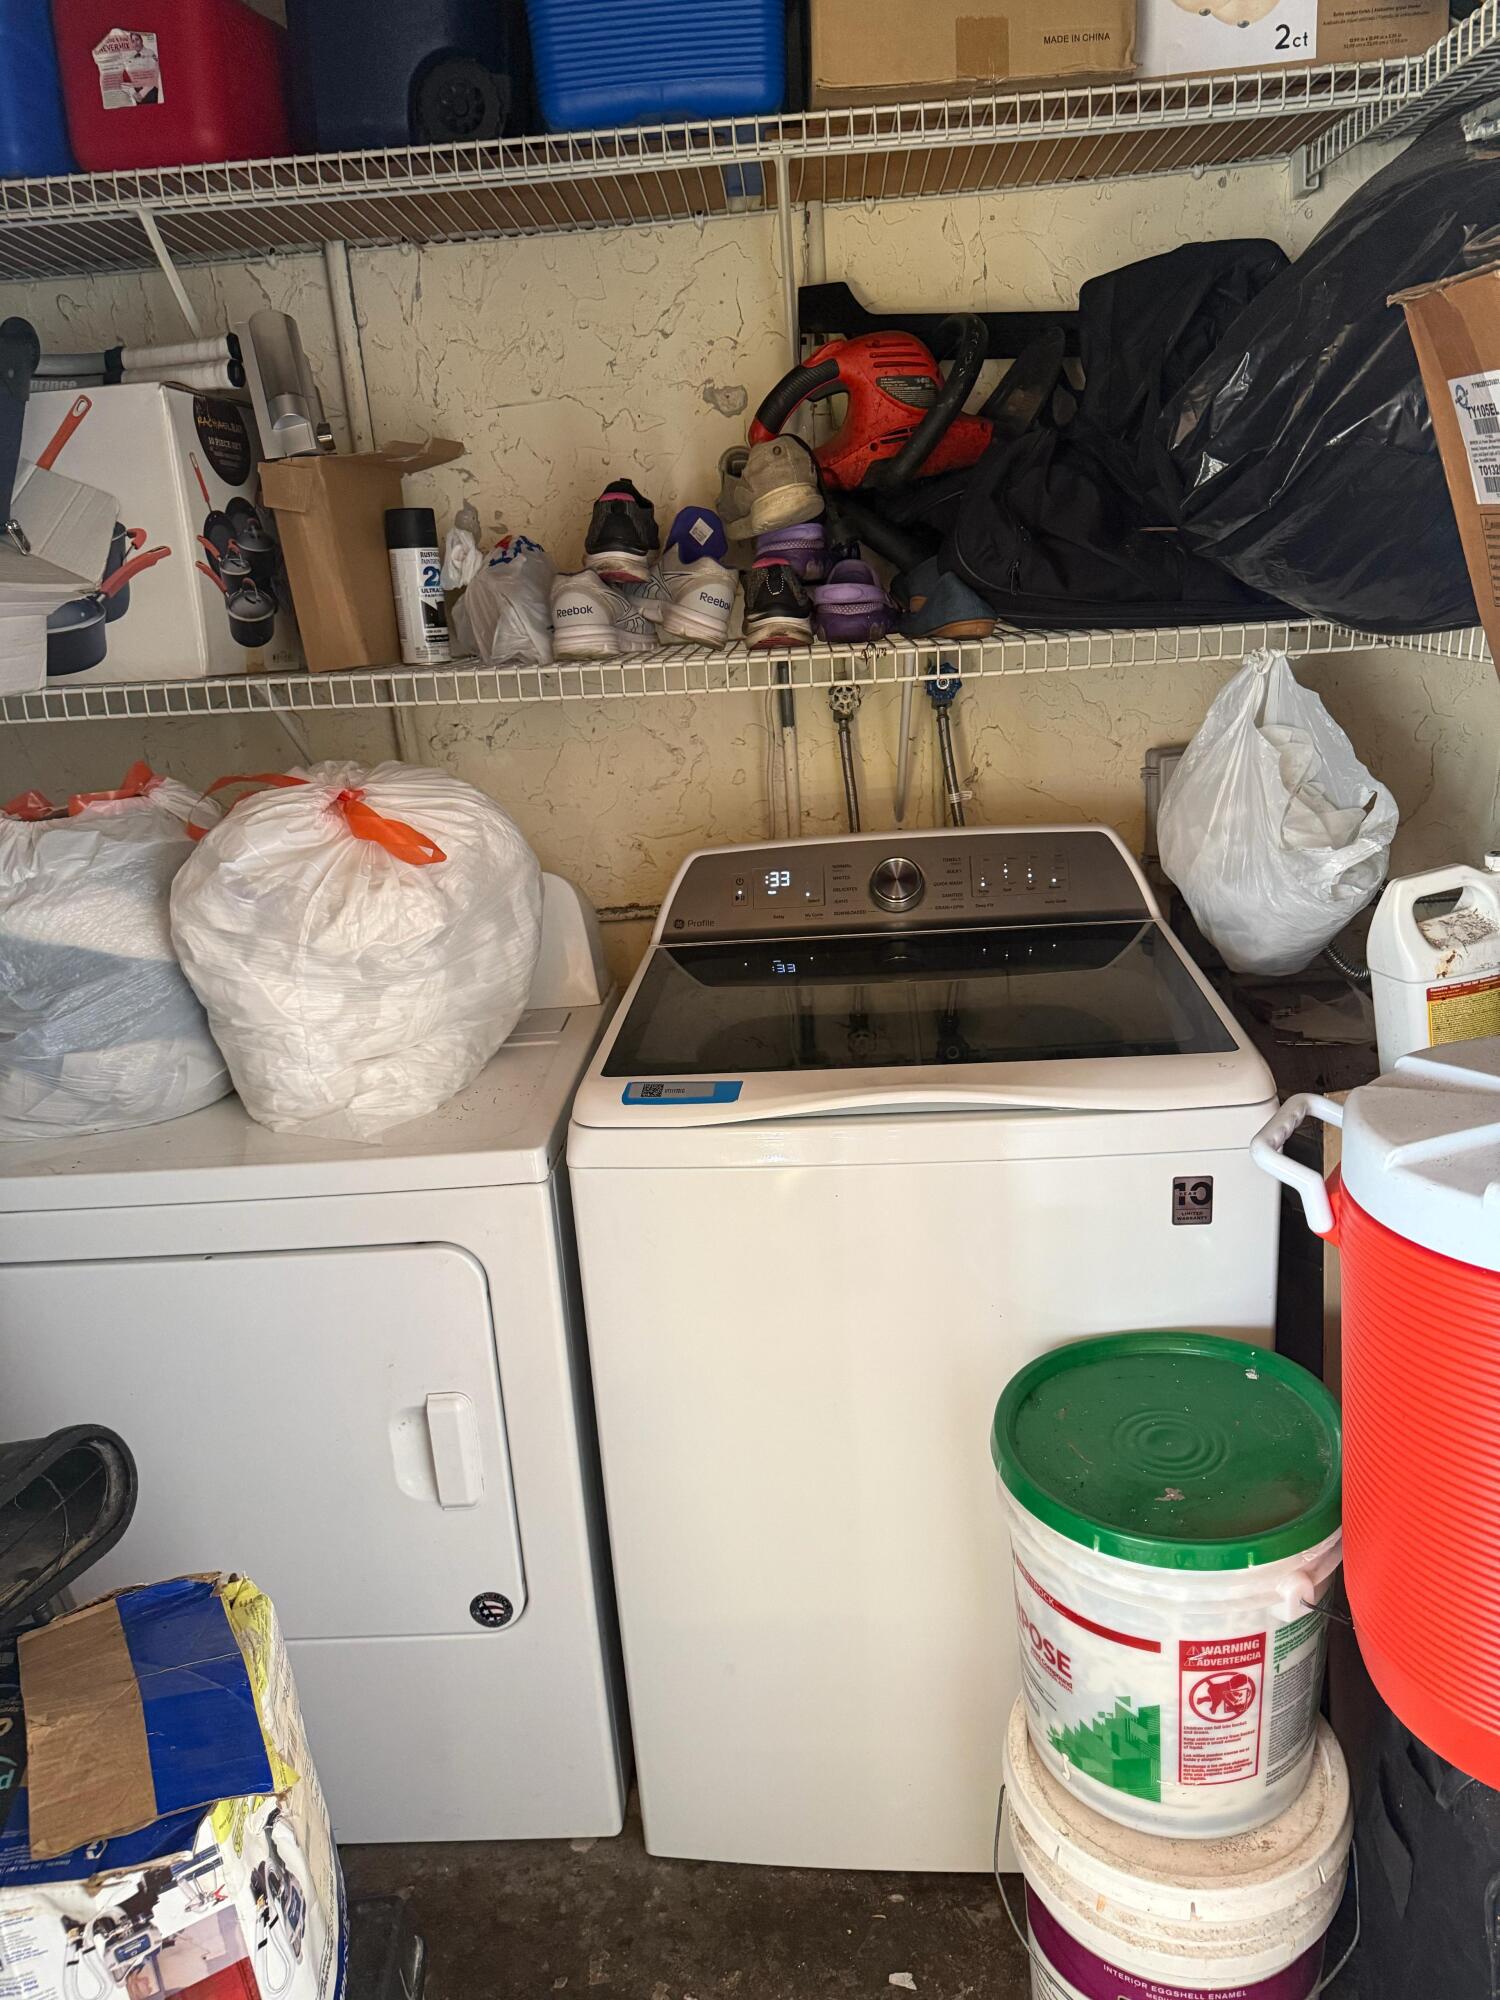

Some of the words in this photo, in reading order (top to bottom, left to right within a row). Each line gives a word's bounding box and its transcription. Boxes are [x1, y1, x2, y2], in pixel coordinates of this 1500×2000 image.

[1043, 35, 1069, 45] MADE
[1071, 34, 1081, 43] IN
[1082, 32, 1111, 42] CHINA
[1467, 402, 1499, 419] TY105EL
[700, 591, 731, 610] Reebok
[556, 605, 593, 619] Reebok
[687, 919, 716, 928] Profile
[1202, 1639, 1260, 1656] WARNING
[1196, 1651, 1262, 1667] ADVERTENCIA
[1103, 1964, 1148, 1989] INTERIOR
[1151, 1985, 1205, 2000] EGGSHELL
[1208, 1989, 1247, 2000] ENAMEL
